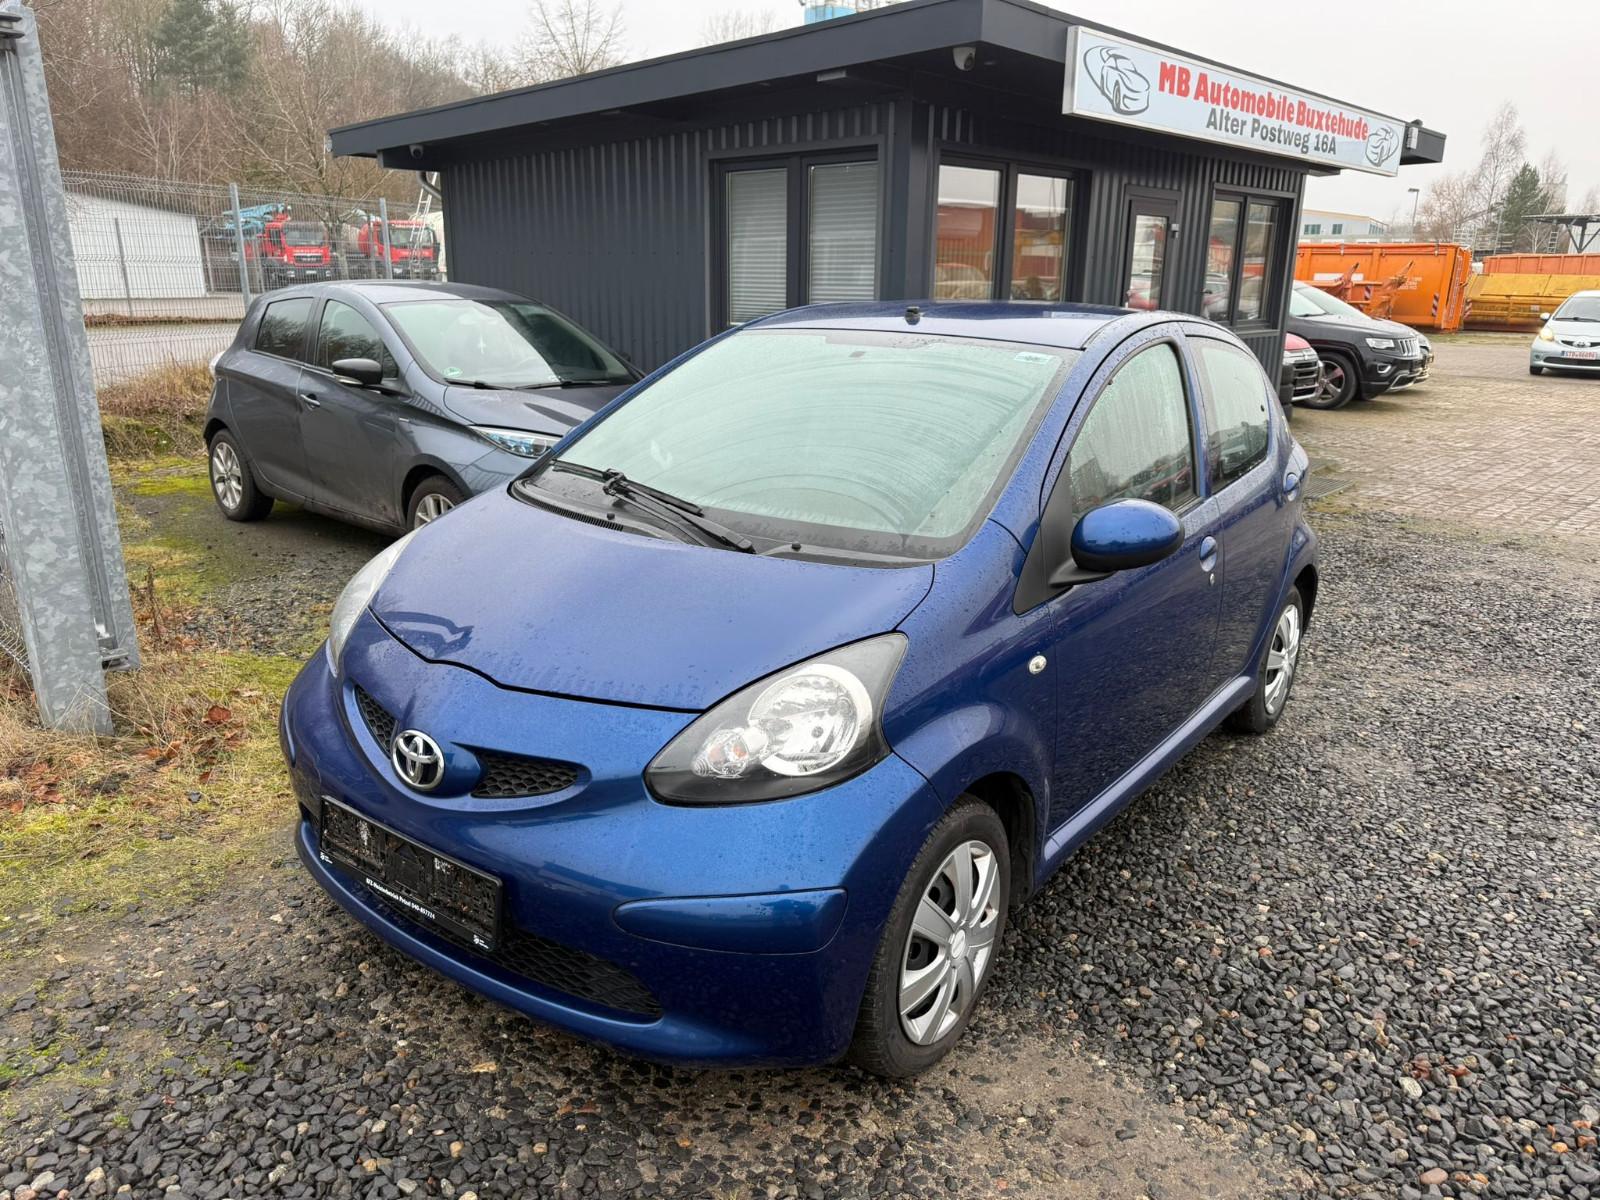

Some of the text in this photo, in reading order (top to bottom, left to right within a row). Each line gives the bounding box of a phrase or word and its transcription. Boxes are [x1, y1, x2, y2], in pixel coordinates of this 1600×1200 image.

[1158, 61, 1369, 141] MB Automobile Buxtehude
[1206, 107, 1337, 155] Alter Postweg 16A
